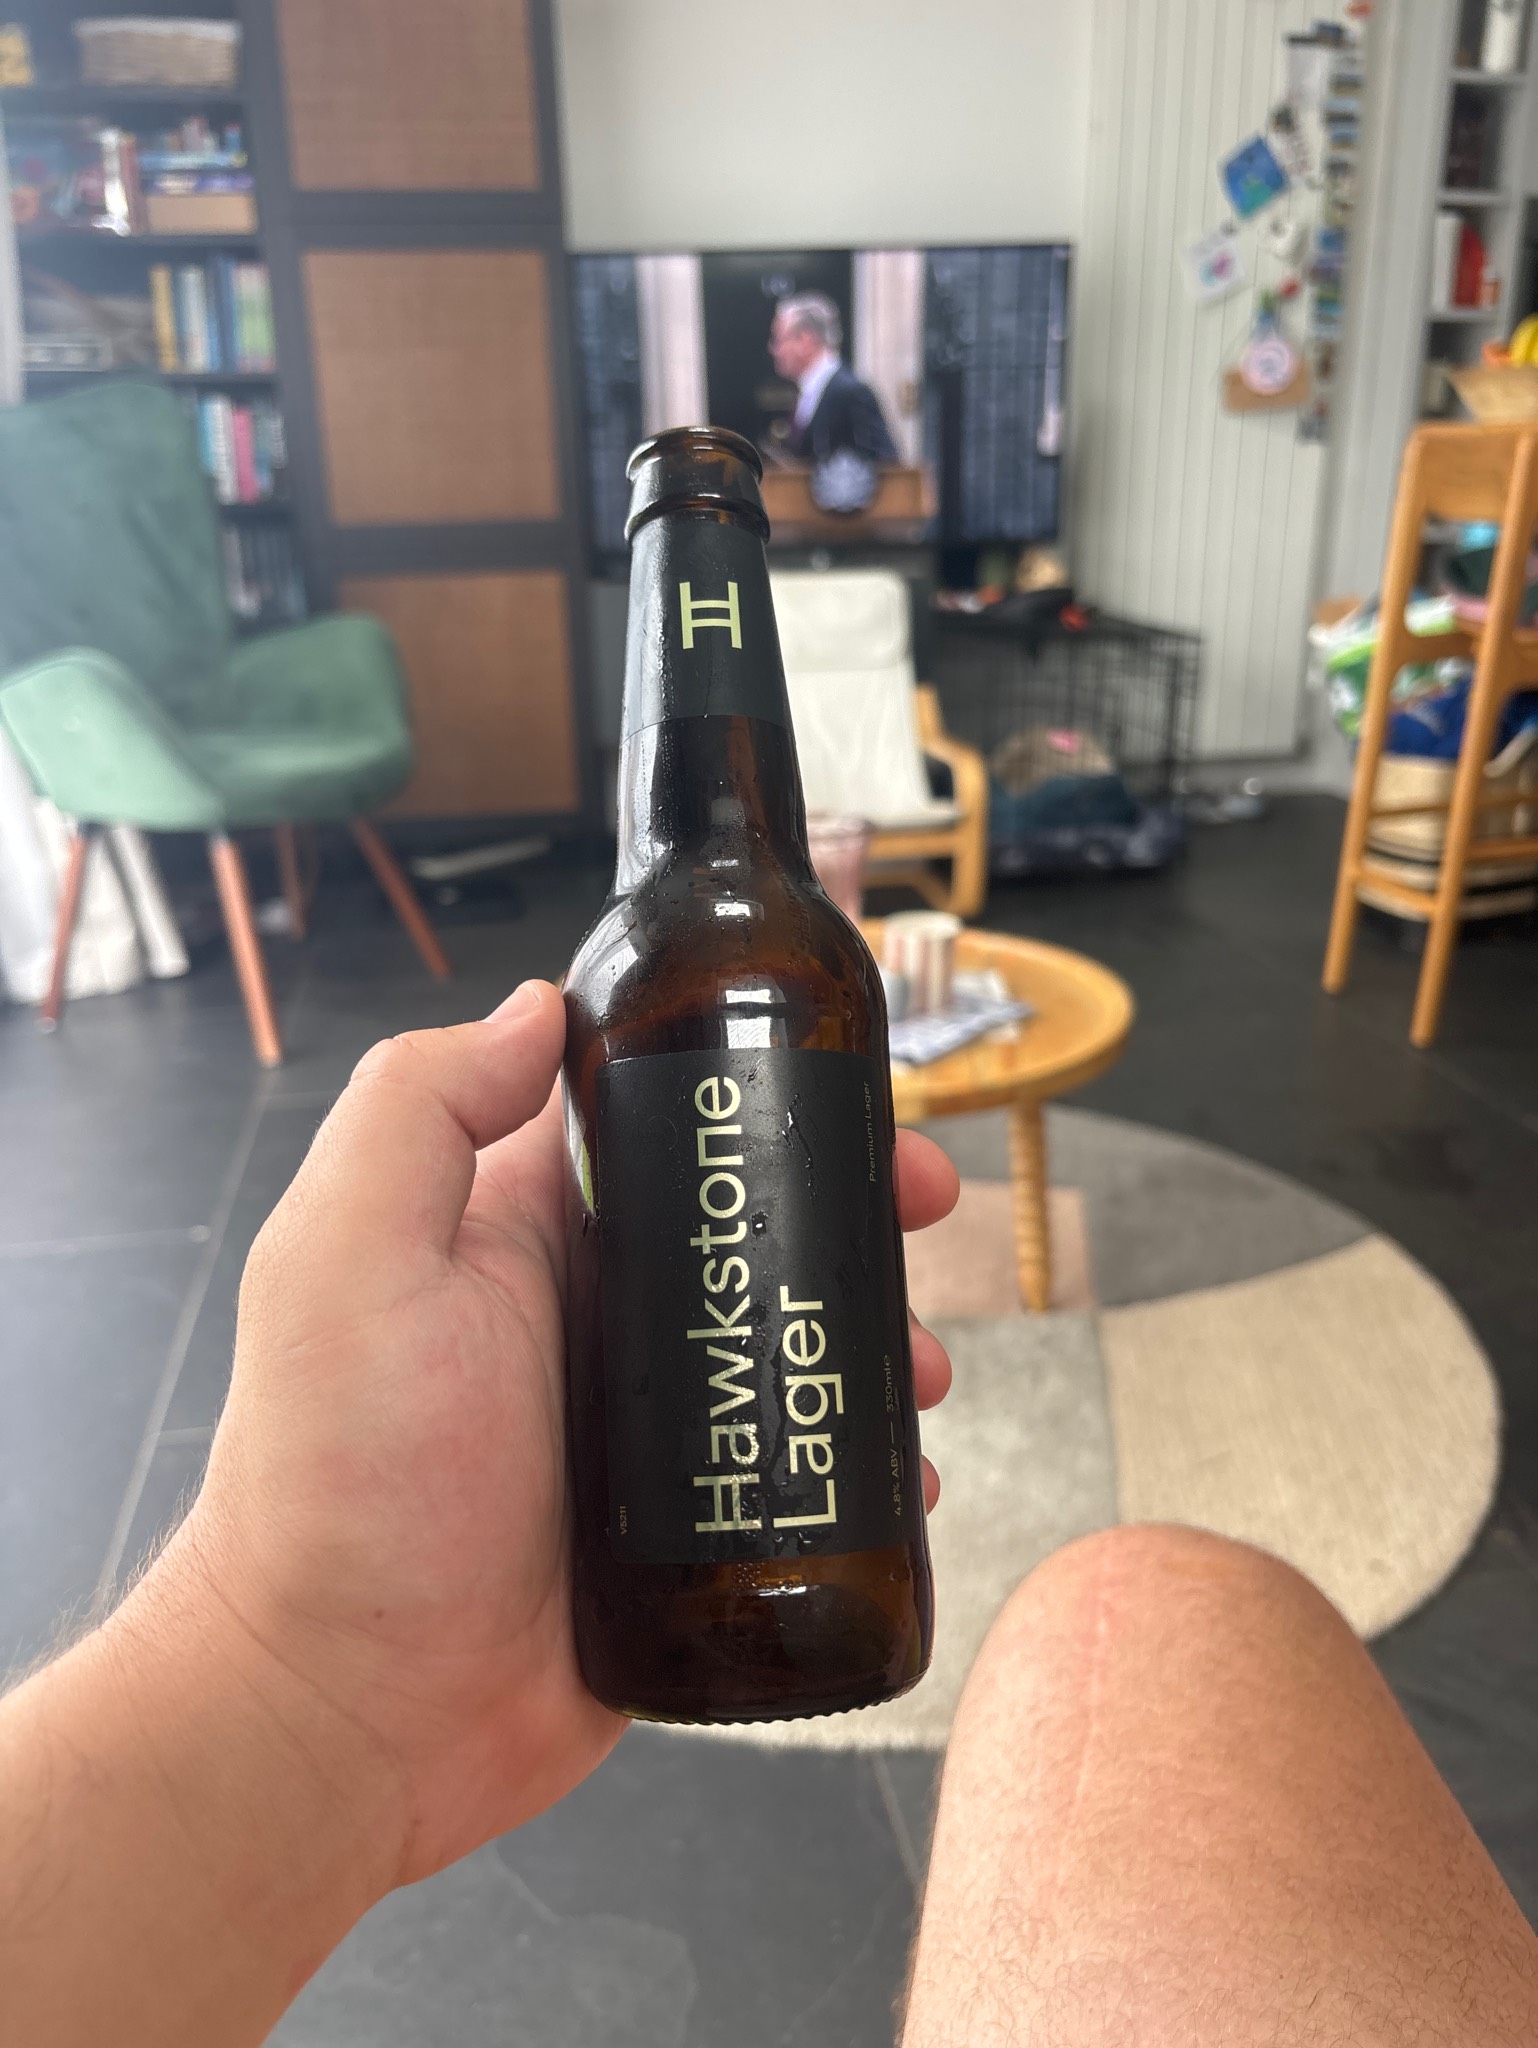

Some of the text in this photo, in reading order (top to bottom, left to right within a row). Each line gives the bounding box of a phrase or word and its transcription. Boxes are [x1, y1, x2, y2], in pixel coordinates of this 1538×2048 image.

[863, 1080, 877, 1183] Premium Lager
[686, 1075, 763, 1534] Hawkstone
[773, 1284, 845, 1529] Lager
[889, 1448, 900, 1479] ABV
[619, 1505, 628, 1536] V5211
[892, 1482, 902, 1516] 4.8%
